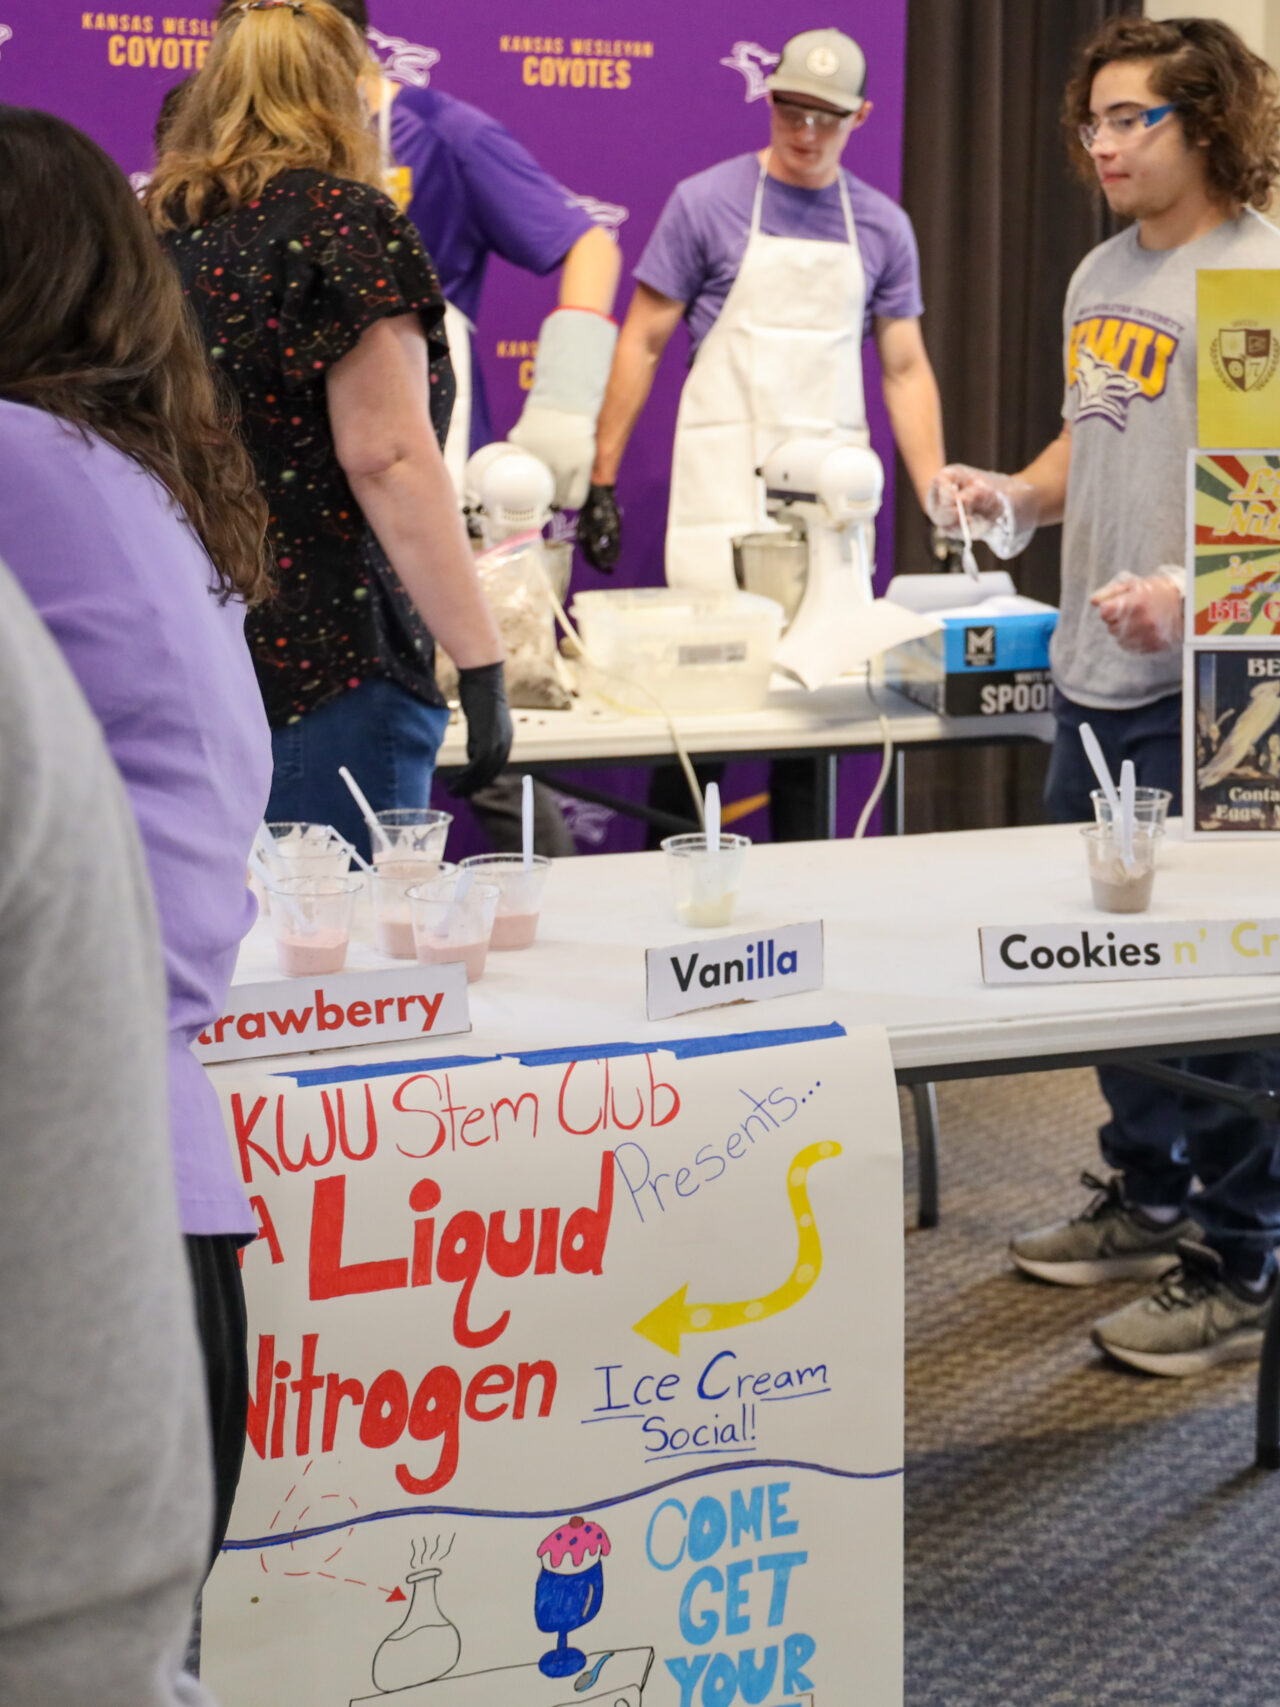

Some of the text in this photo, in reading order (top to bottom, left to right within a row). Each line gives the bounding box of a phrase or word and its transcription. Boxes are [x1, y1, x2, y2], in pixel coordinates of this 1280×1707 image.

[81, 12, 154, 33] KANSAS
[108, 34, 211, 70] COYOTE
[499, 35, 654, 58] KANSAS WESLEYAN
[522, 55, 632, 89] COYOTES
[1208, 600, 1252, 622] BE
[981, 683, 1054, 714] SPOO
[1214, 804, 1266, 822] Eggs,
[670, 938, 798, 992] Vanilla
[999, 931, 1161, 970] Cookies
[231, 1053, 681, 1183] KWU Stem Club
[237, 1150, 615, 1349] A Liquid
[593, 1350, 828, 1412] Ice Cream
[642, 1403, 756, 1452] Social!
[646, 1481, 799, 1571] COME
[679, 1551, 808, 1646] GET
[664, 1633, 816, 1707] YOUR
